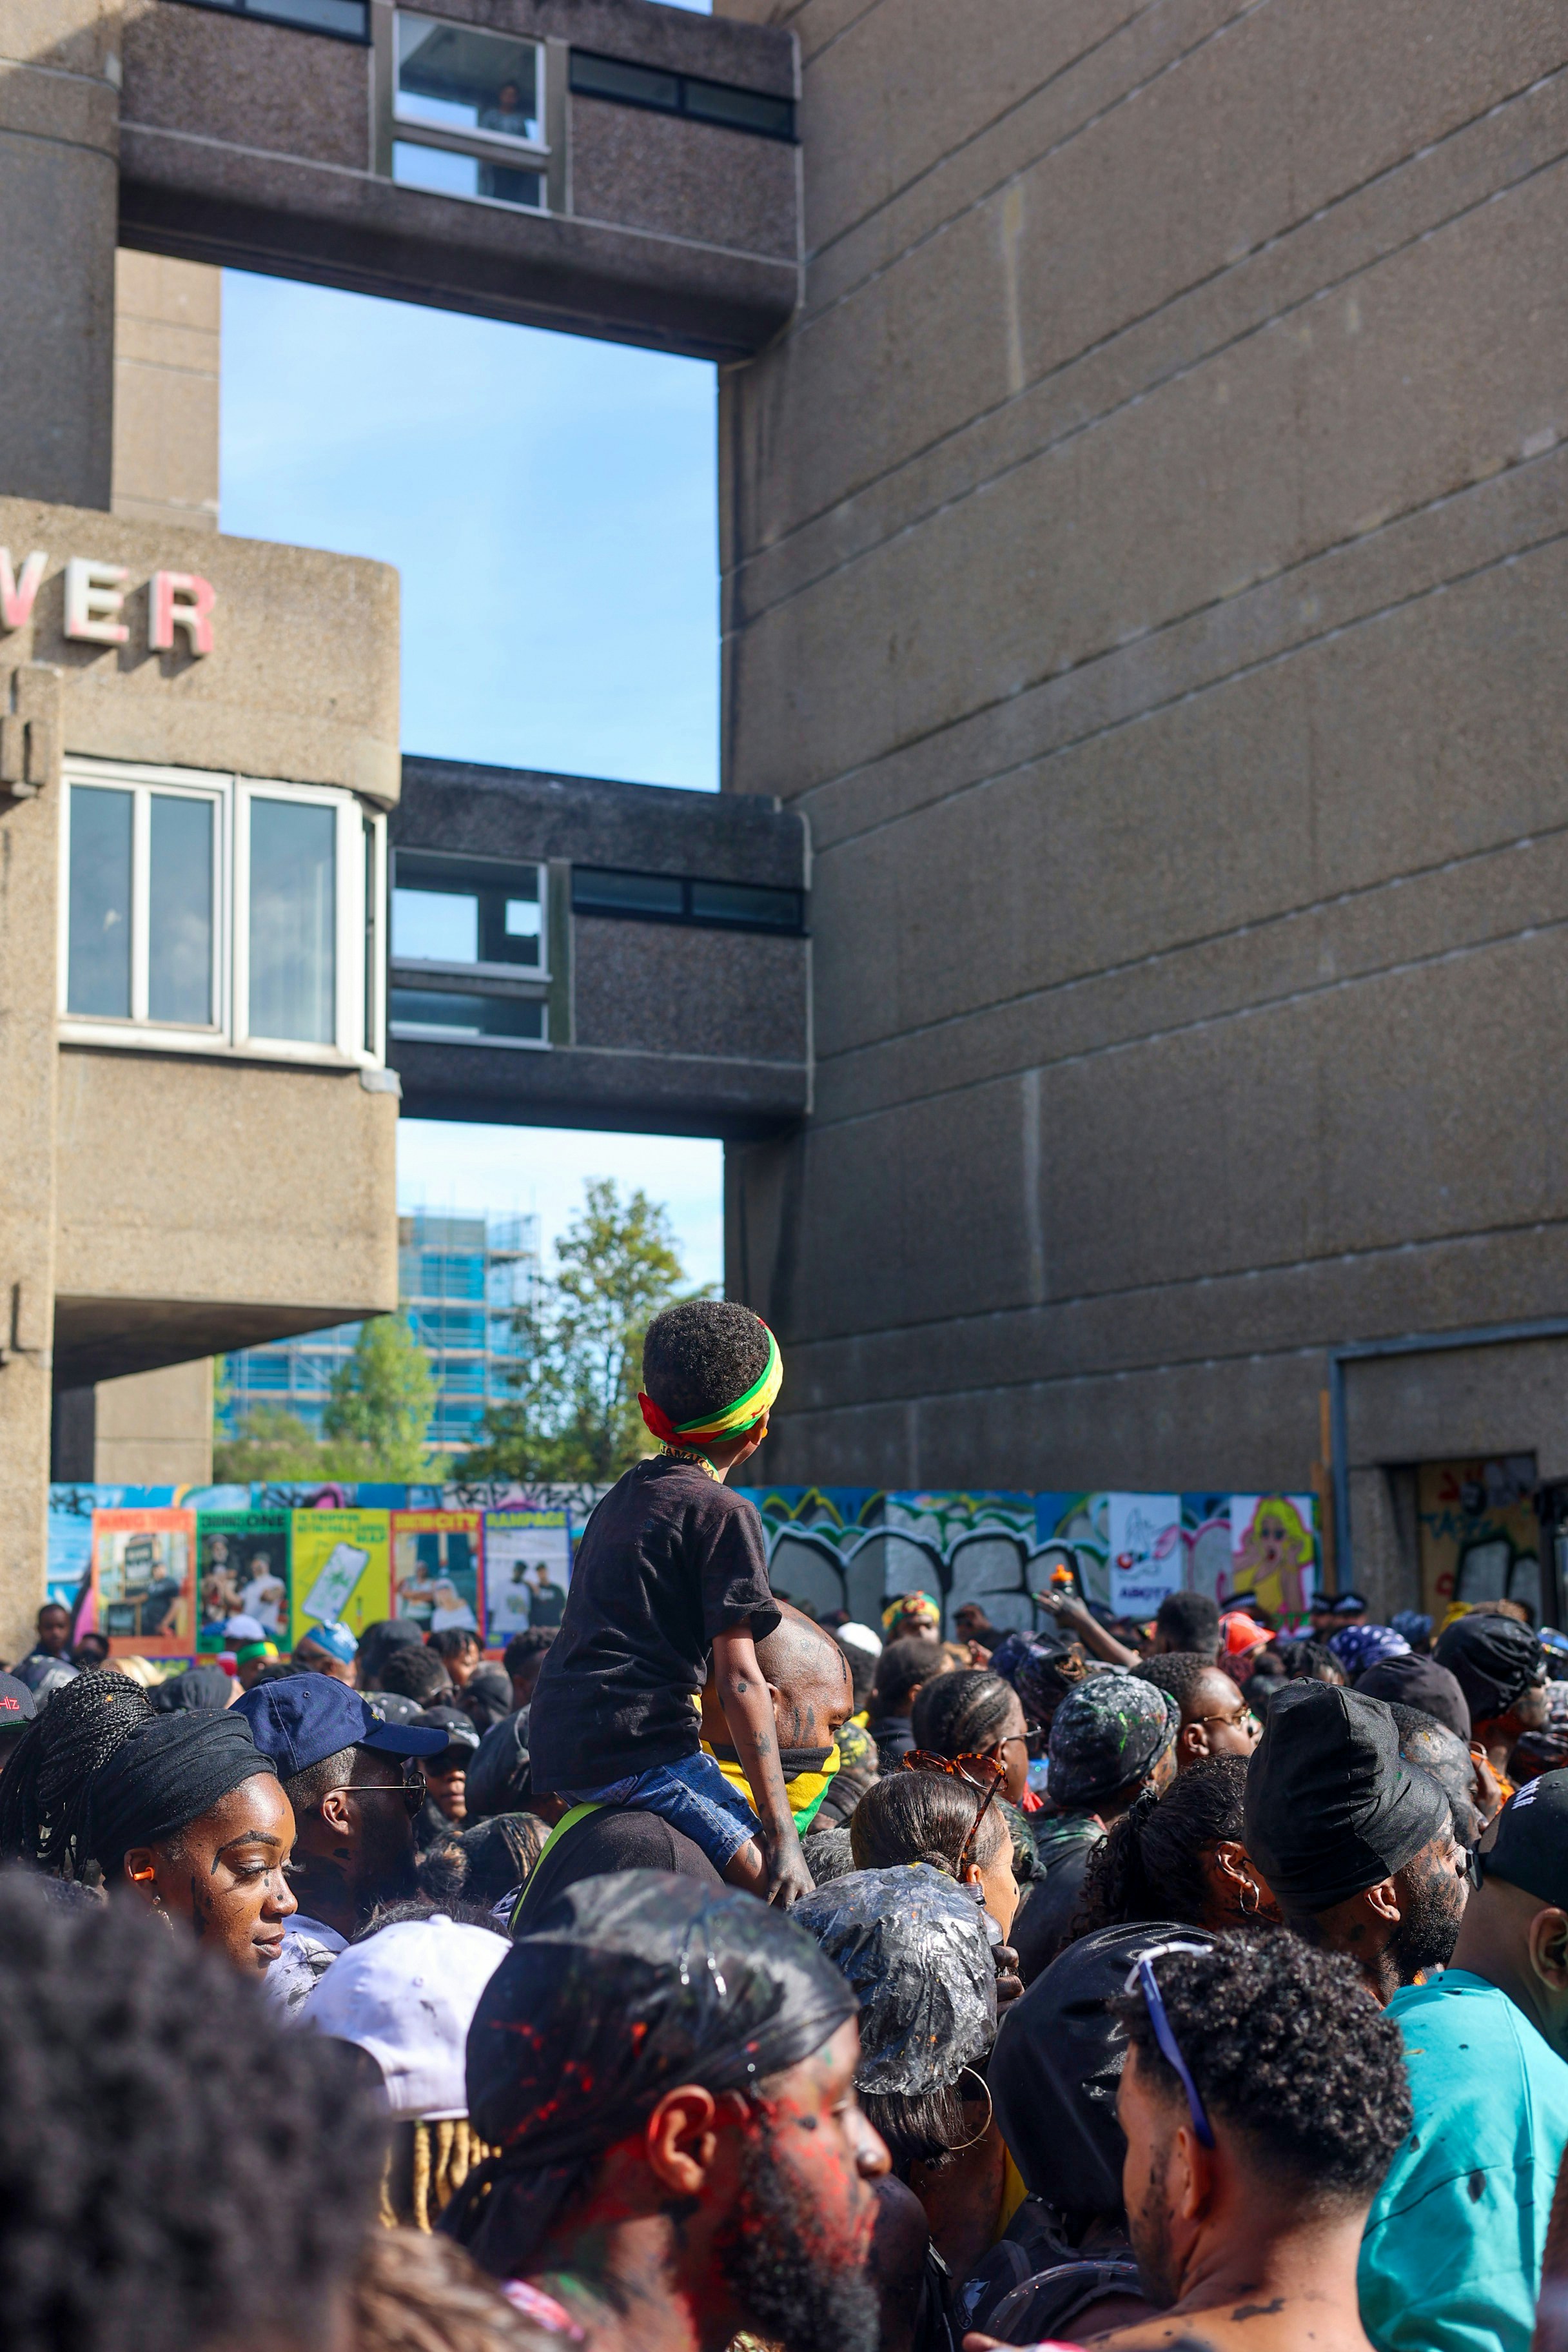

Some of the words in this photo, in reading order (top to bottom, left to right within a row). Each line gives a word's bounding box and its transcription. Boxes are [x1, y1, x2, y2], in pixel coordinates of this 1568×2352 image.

[660, 1445, 714, 1479] JAMAICA
[435, 1512, 480, 1529] CITY
[485, 1511, 567, 1528] RAMPAGE
